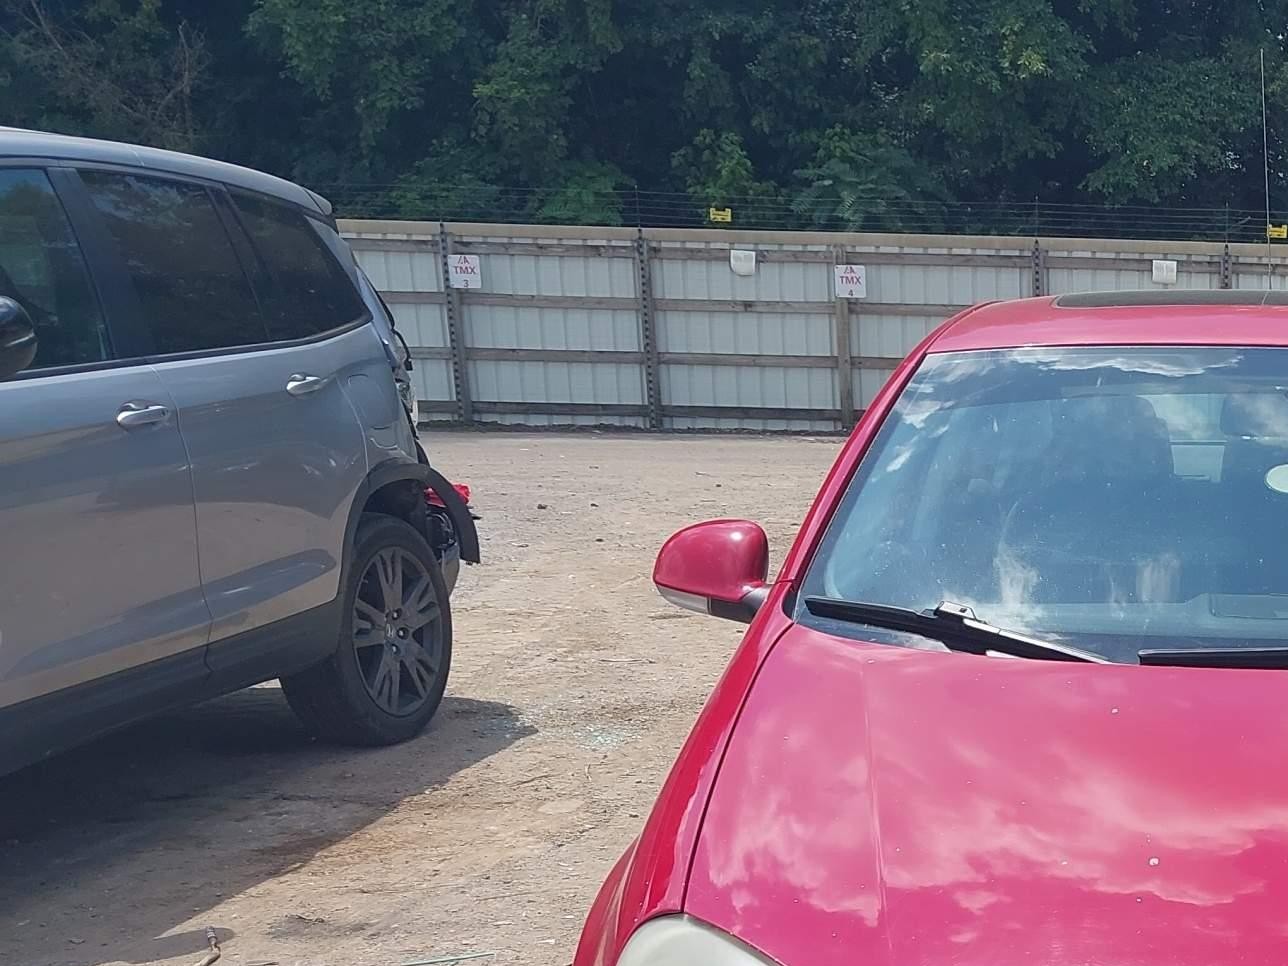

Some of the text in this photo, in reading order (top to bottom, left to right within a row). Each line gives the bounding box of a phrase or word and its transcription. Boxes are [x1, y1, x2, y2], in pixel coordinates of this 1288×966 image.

[454, 266, 477, 275] TMX
[463, 279, 470, 288] 3
[840, 276, 862, 285] TMX
[847, 289, 855, 297] 4
